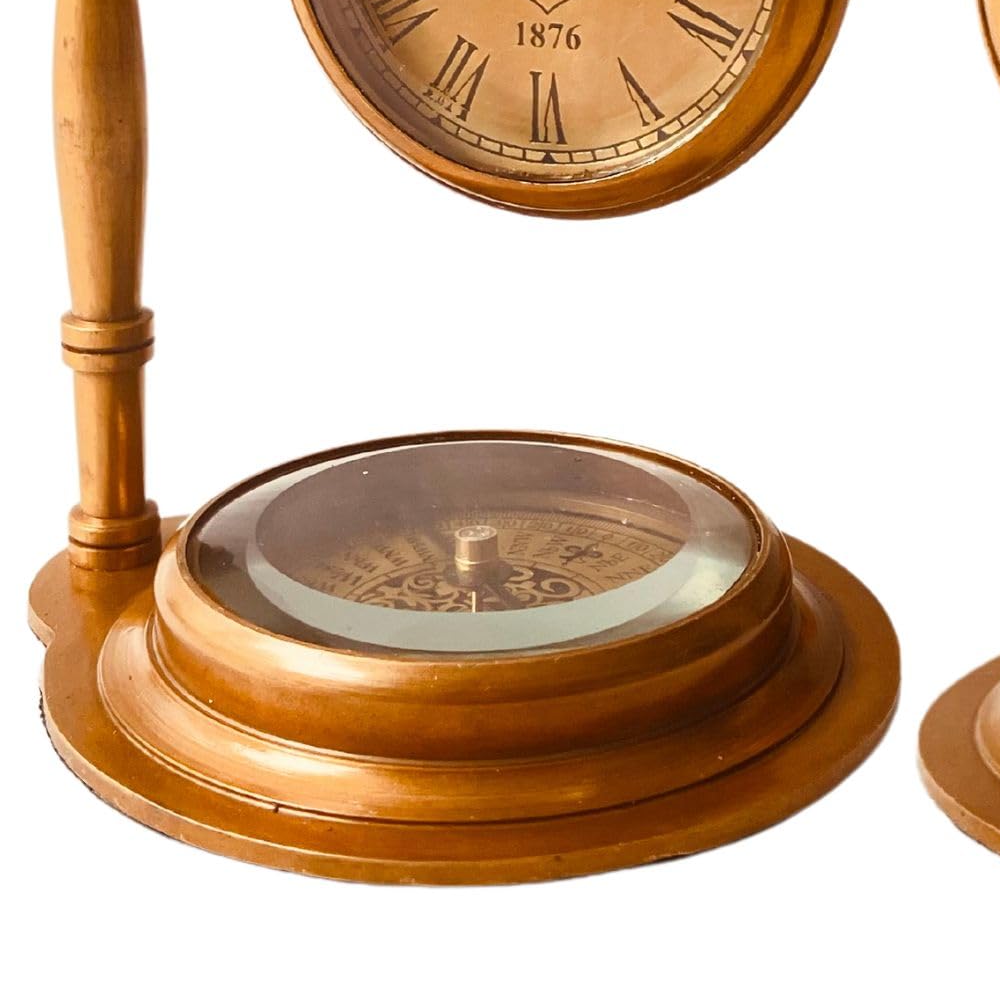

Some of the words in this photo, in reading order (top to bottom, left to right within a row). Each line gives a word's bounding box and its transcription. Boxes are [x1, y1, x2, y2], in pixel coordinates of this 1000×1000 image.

[516, 21, 582, 51] 1876
[428, 34, 491, 122] VII
[529, 70, 568, 145] VI
[617, 56, 666, 128] V
